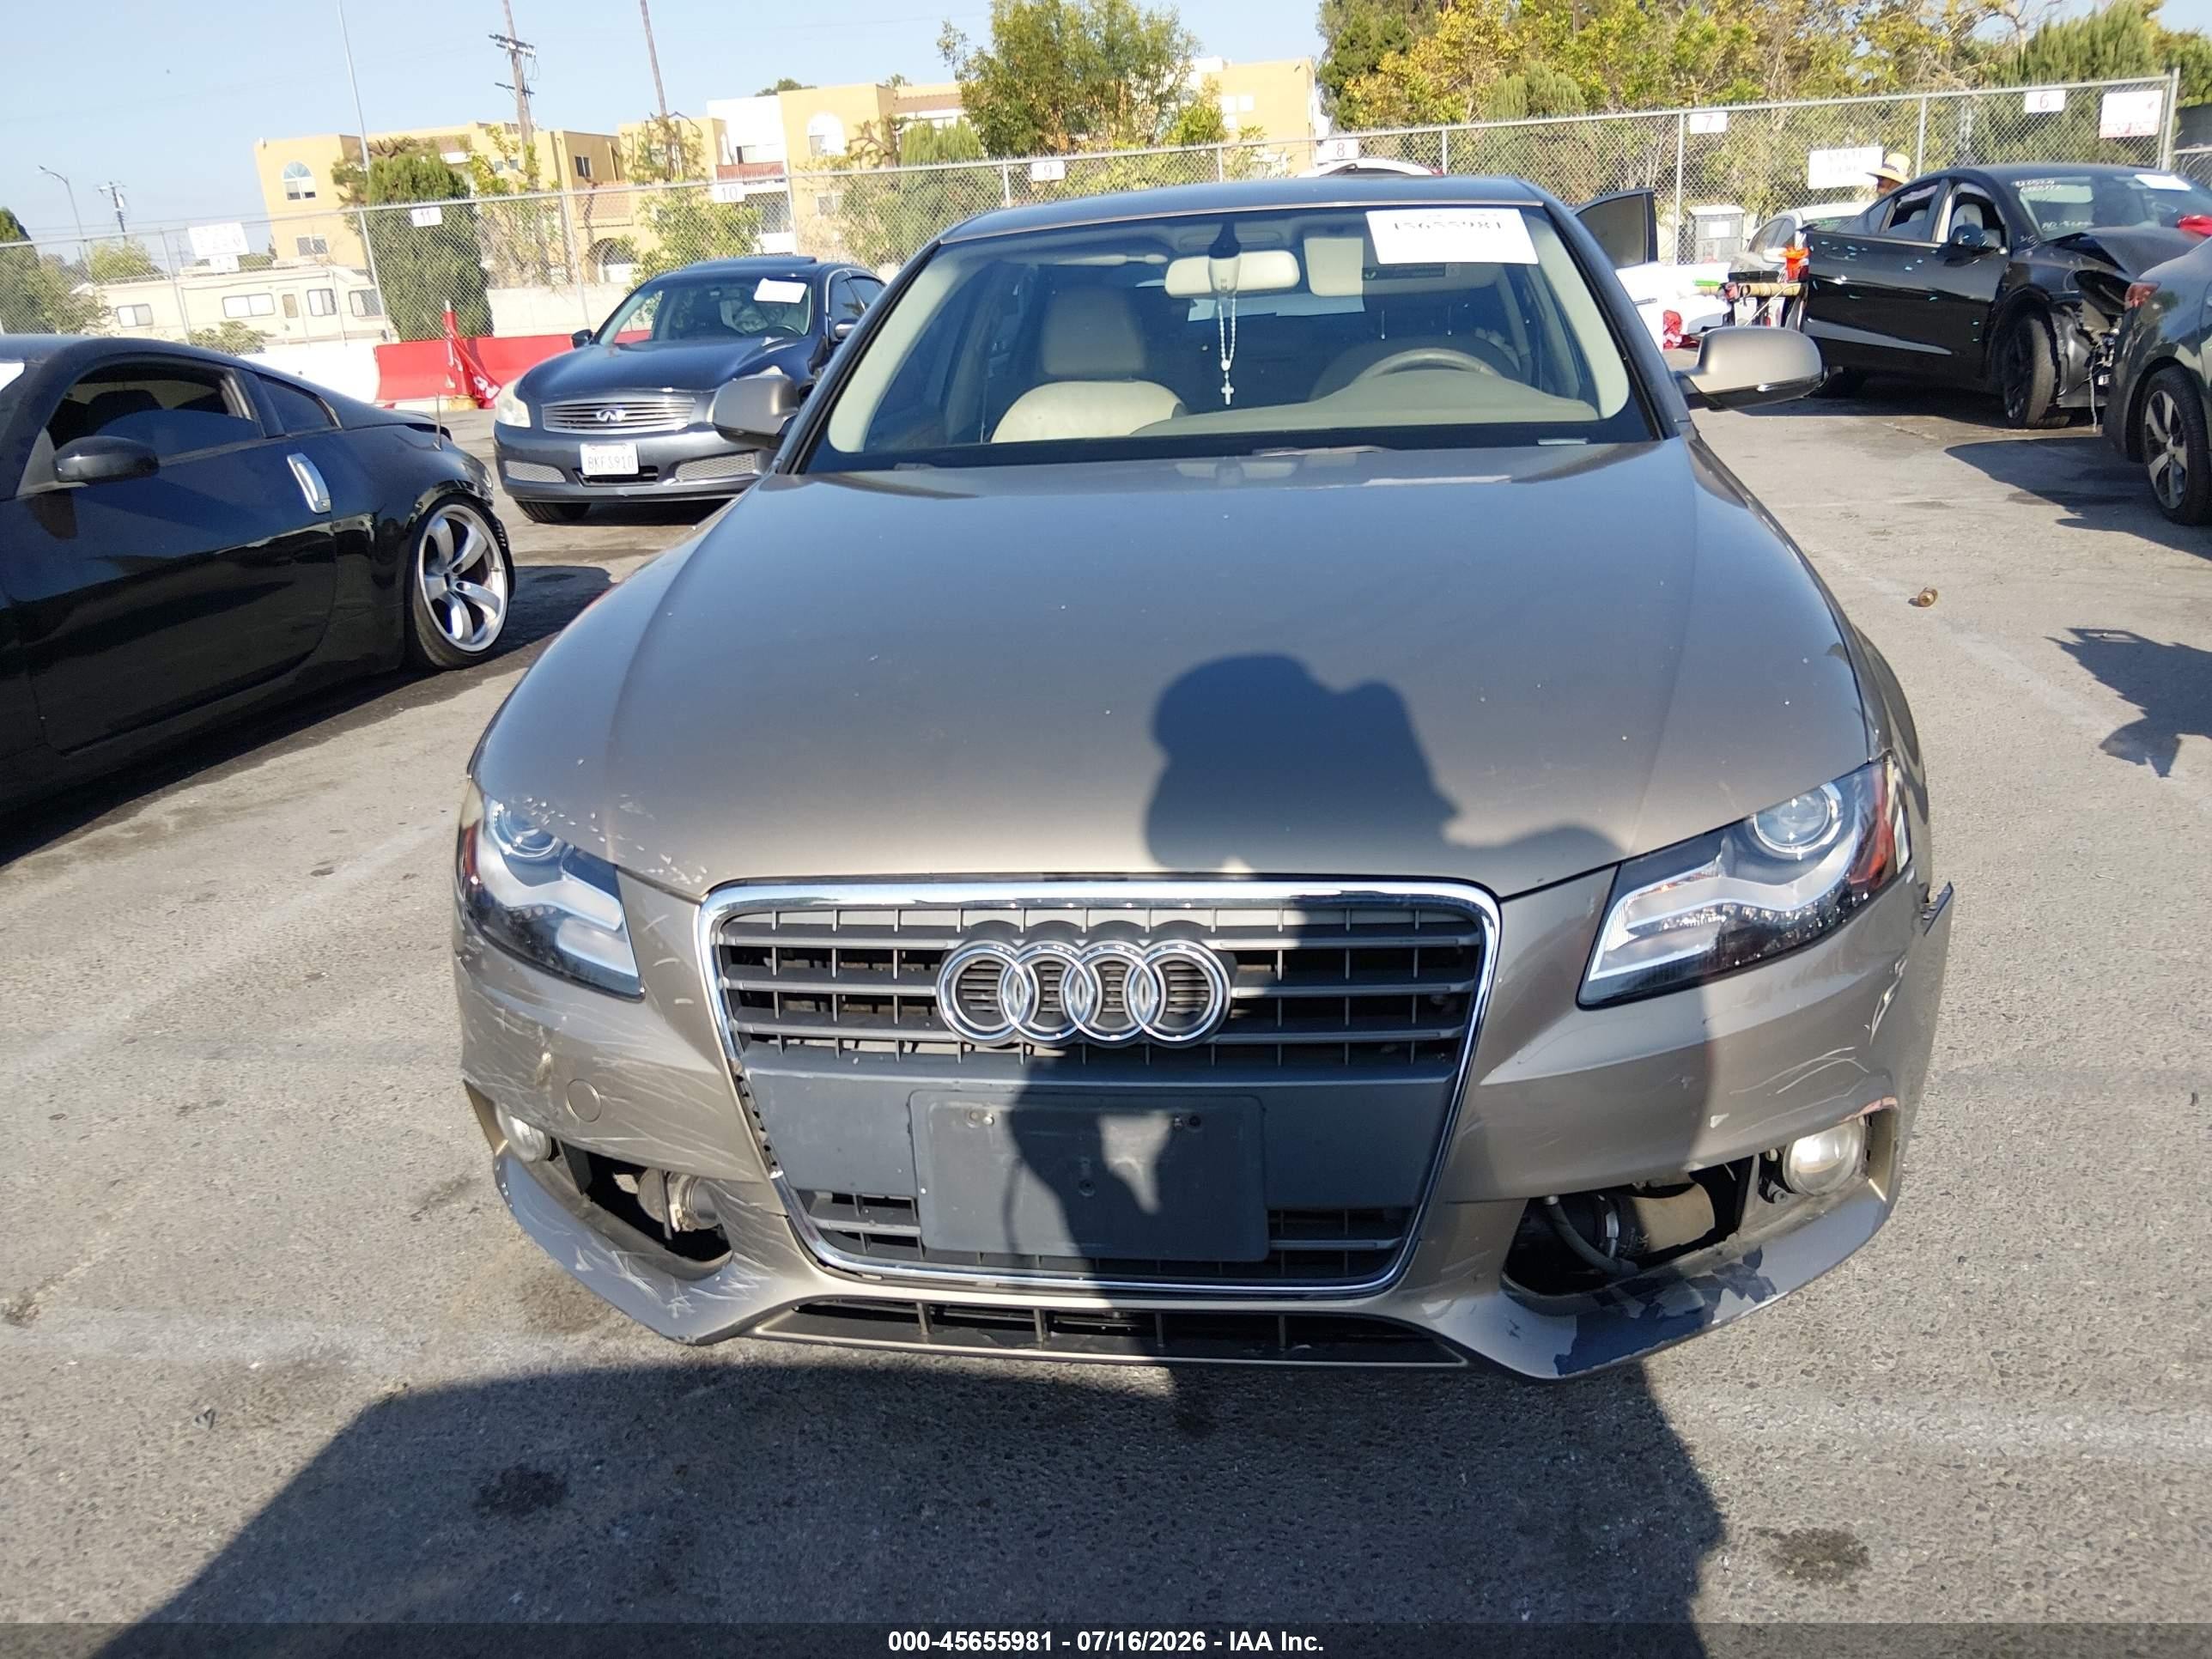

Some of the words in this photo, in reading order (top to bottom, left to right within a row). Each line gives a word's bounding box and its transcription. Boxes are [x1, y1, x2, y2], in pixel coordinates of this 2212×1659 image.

[2039, 93, 2049, 109] 6
[1704, 114, 1713, 131] 7
[1336, 142, 1346, 158] 8
[1043, 164, 1053, 179] 9
[721, 185, 738, 200] 10
[419, 209, 434, 222] 11
